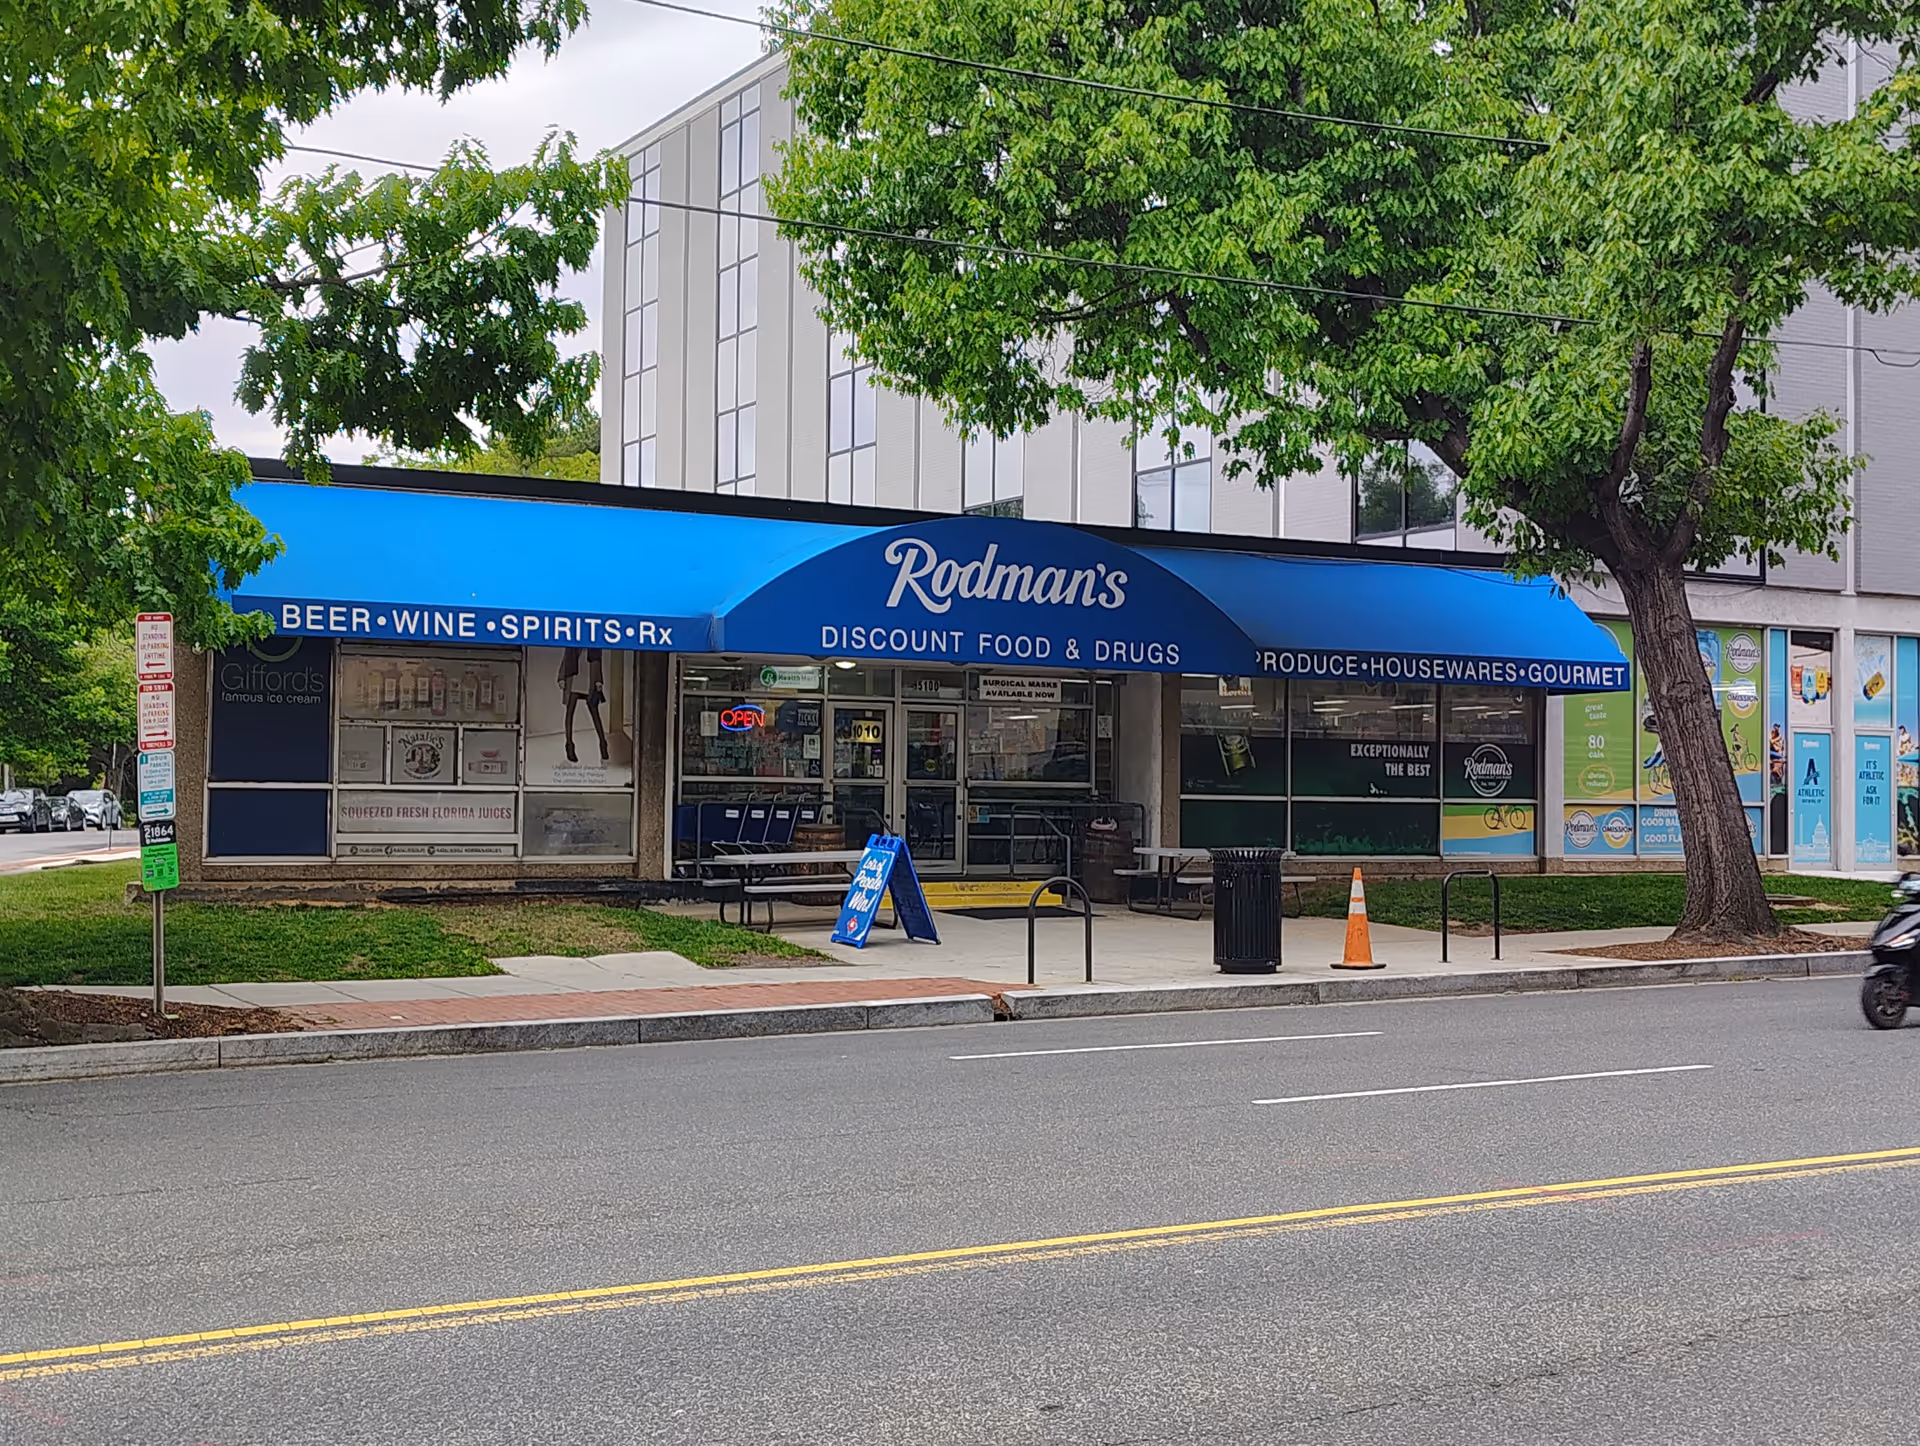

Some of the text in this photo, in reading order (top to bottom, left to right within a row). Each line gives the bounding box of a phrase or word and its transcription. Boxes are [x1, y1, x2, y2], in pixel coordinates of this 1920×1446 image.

[885, 538, 1128, 614] Rodman's
[282, 604, 673, 645] BEER WINE SPIRITS Rx
[821, 625, 1180, 665] DISCOUNT FOOD & DRUGS
[1371, 655, 1517, 682] HOUSEWARES
[1528, 663, 1625, 686] GOURMET
[220, 663, 325, 694] Gifford's
[983, 679, 1058, 689] SURGICAL MASKS
[221, 692, 321, 704] famous ice cream
[986, 690, 1032, 698] AVAILABLE
[1585, 703, 1603, 714] great
[720, 709, 766, 728] OPEN
[853, 724, 880, 739] 10 10
[1588, 735, 1605, 750] 80
[1350, 743, 1430, 758] EXCEPTIONALLY
[1385, 762, 1431, 777] THE BEST
[1464, 757, 1513, 780] Rodman's
[1859, 771, 1885, 781] ATHLETIC
[1797, 788, 1825, 798] ATHLETIC
[341, 806, 512, 820] SQUEEZED FRESH FLORIDA JUICES
[1602, 825, 1633, 833] OMISSION
[1641, 817, 1664, 827] GOOD
[144, 825, 174, 838] 21864
[1644, 833, 1667, 843] GOOD
